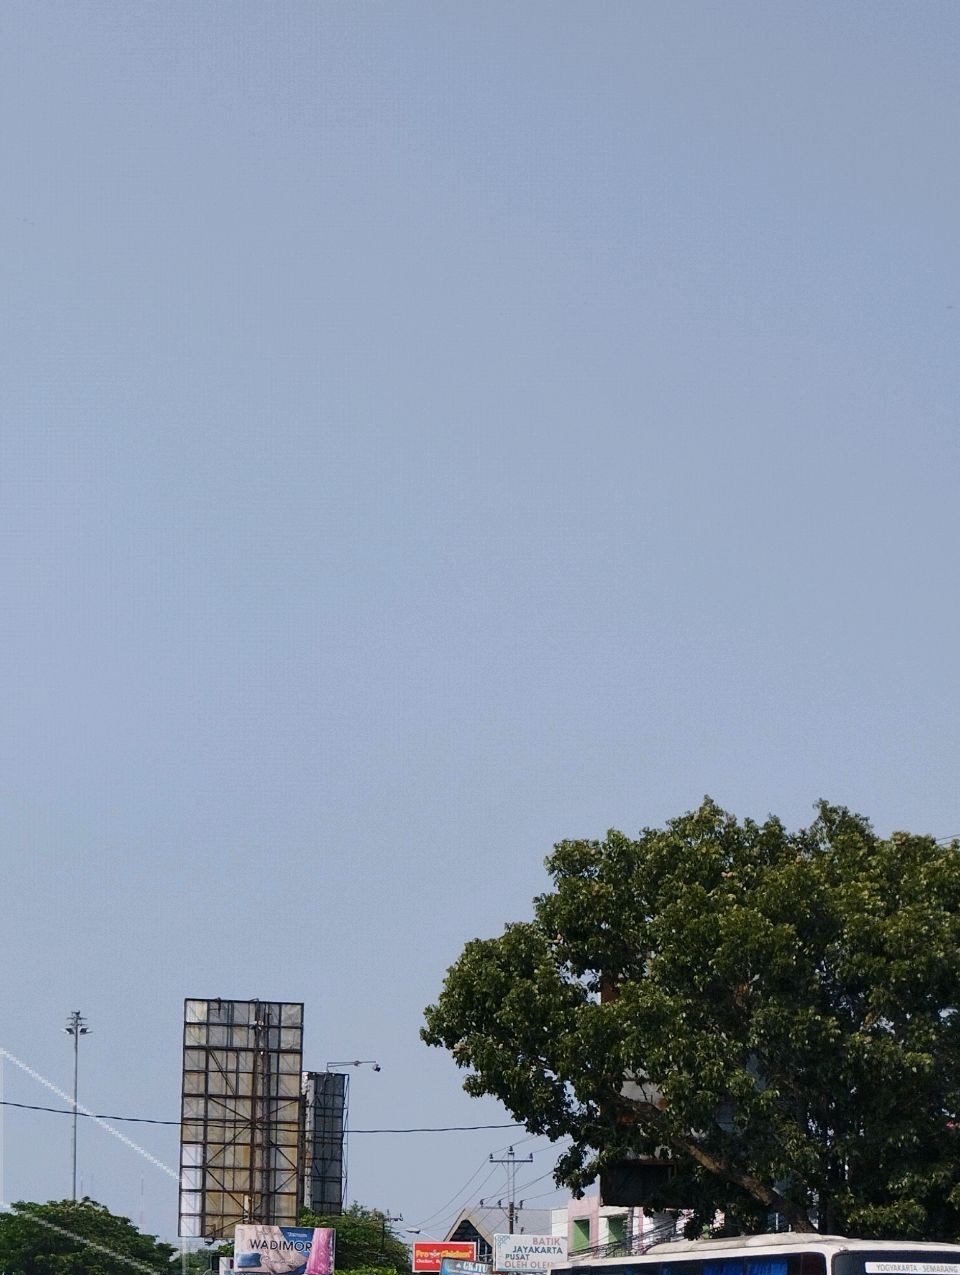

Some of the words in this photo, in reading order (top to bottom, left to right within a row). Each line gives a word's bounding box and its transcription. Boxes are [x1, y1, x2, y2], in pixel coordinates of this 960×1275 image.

[250, 1239, 312, 1252] WADIMOR
[532, 1237, 560, 1246] BATIK
[415, 1249, 429, 1258] Pro
[512, 1245, 563, 1254] JAYAKARTA
[505, 1253, 530, 1261] PUSAT
[504, 1261, 528, 1269] OLEH
[876, 1263, 918, 1272] YOGYAKARTA
[922, 1265, 959, 1273] SEMARANG
